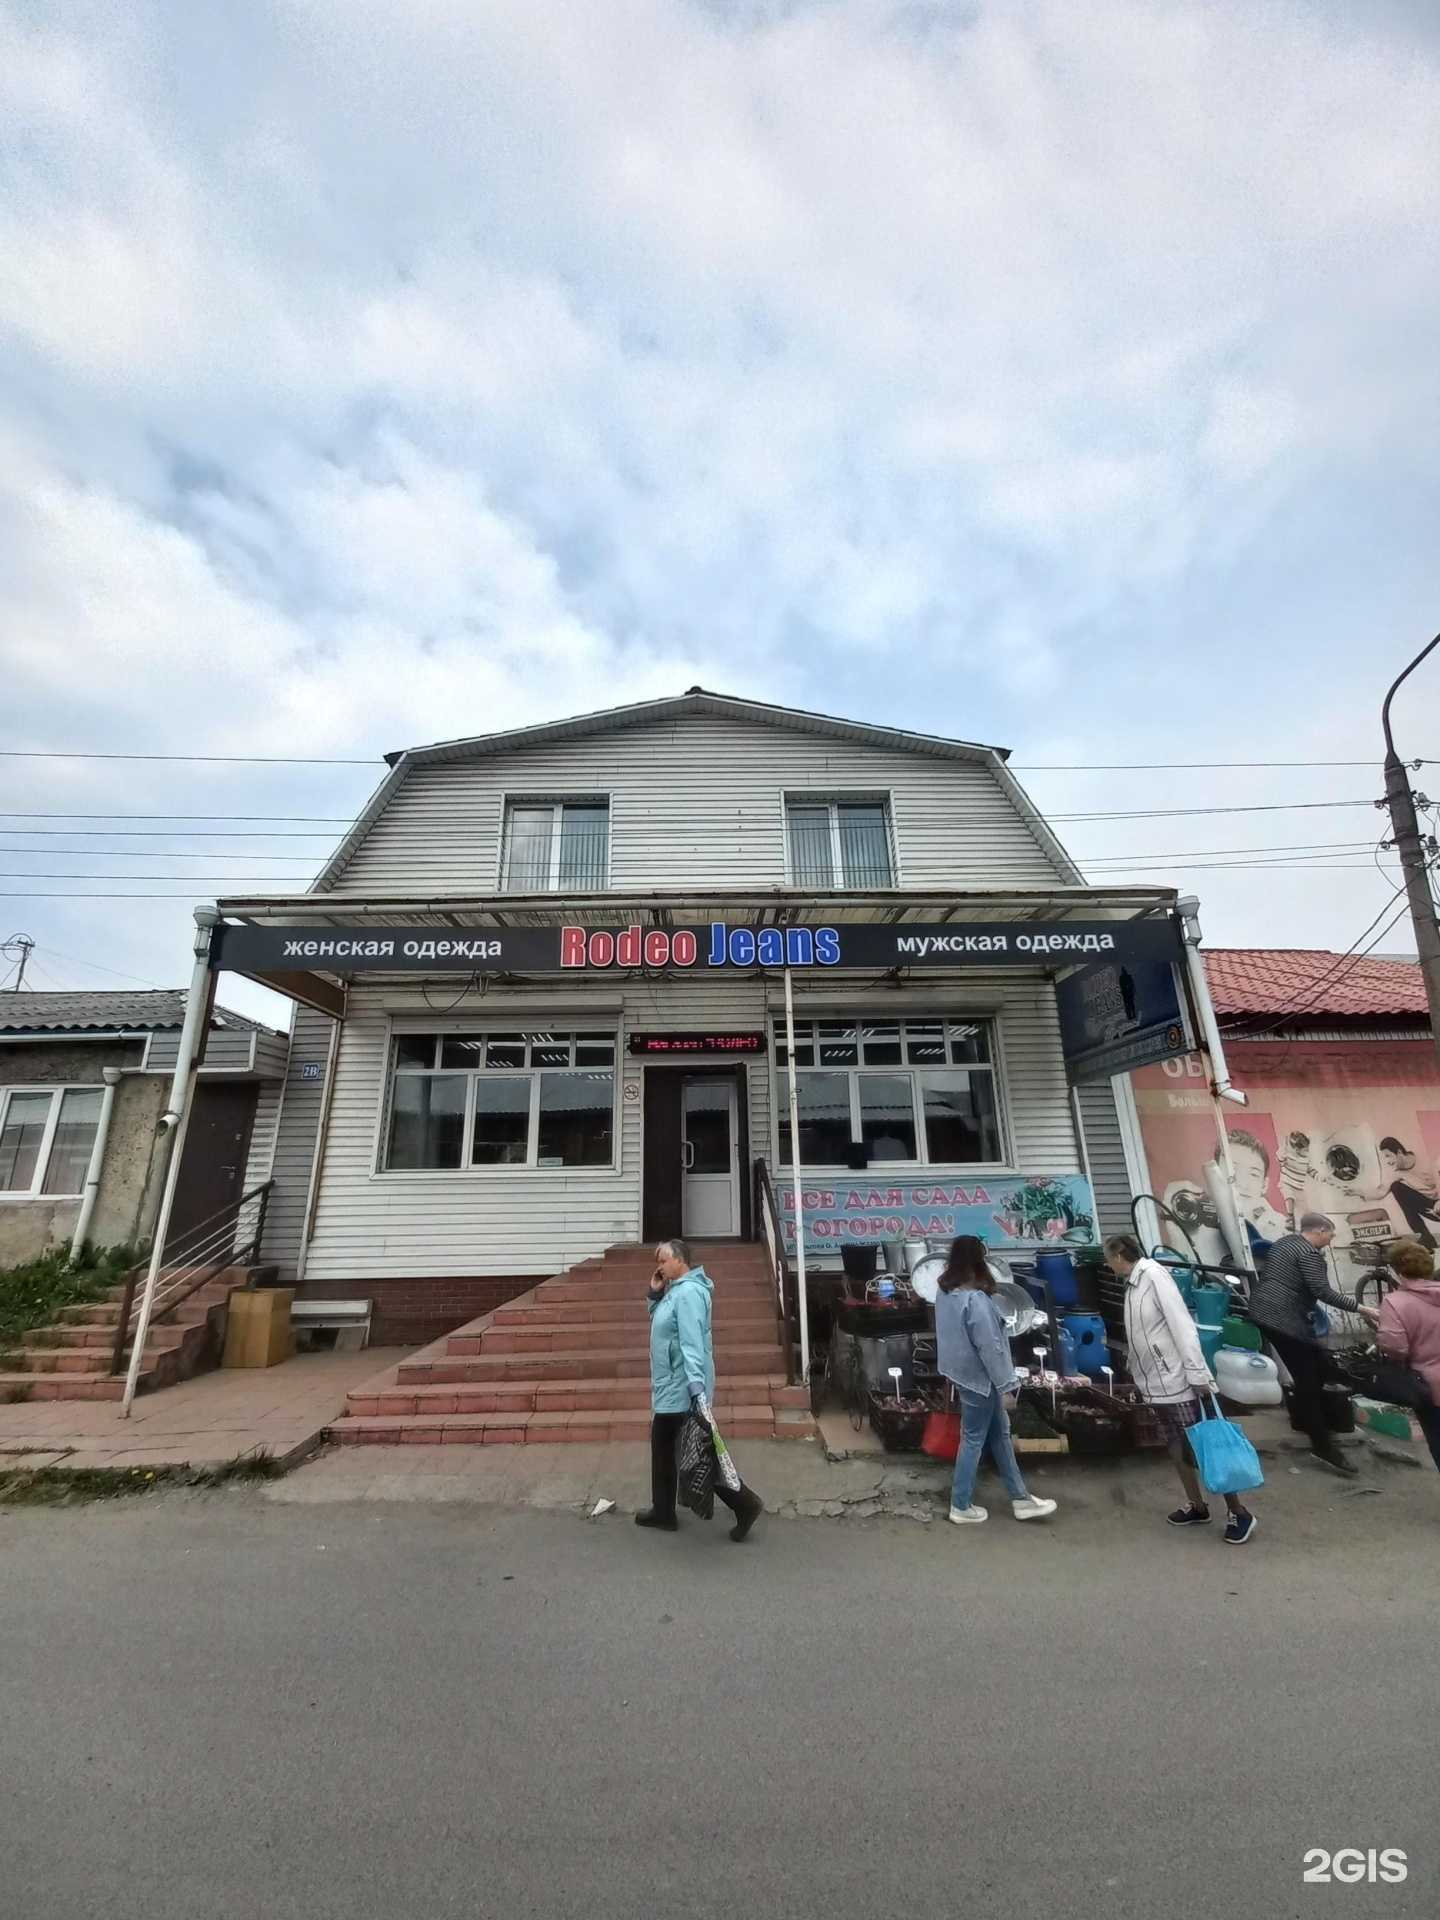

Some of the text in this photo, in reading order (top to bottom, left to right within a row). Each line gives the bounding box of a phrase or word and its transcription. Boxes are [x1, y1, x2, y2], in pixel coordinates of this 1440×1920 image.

[282, 940, 502, 959] женская одежда
[560, 922, 841, 967] Rodeo Jeans
[897, 933, 1115, 957] мужская одежда
[845, 1187, 905, 1210] ДЛЯ
[911, 1184, 992, 1207] САДА
[813, 1214, 954, 1238] ОГОРОДА!
[1353, 1225, 1390, 1238] ЭКСПЕРТ
